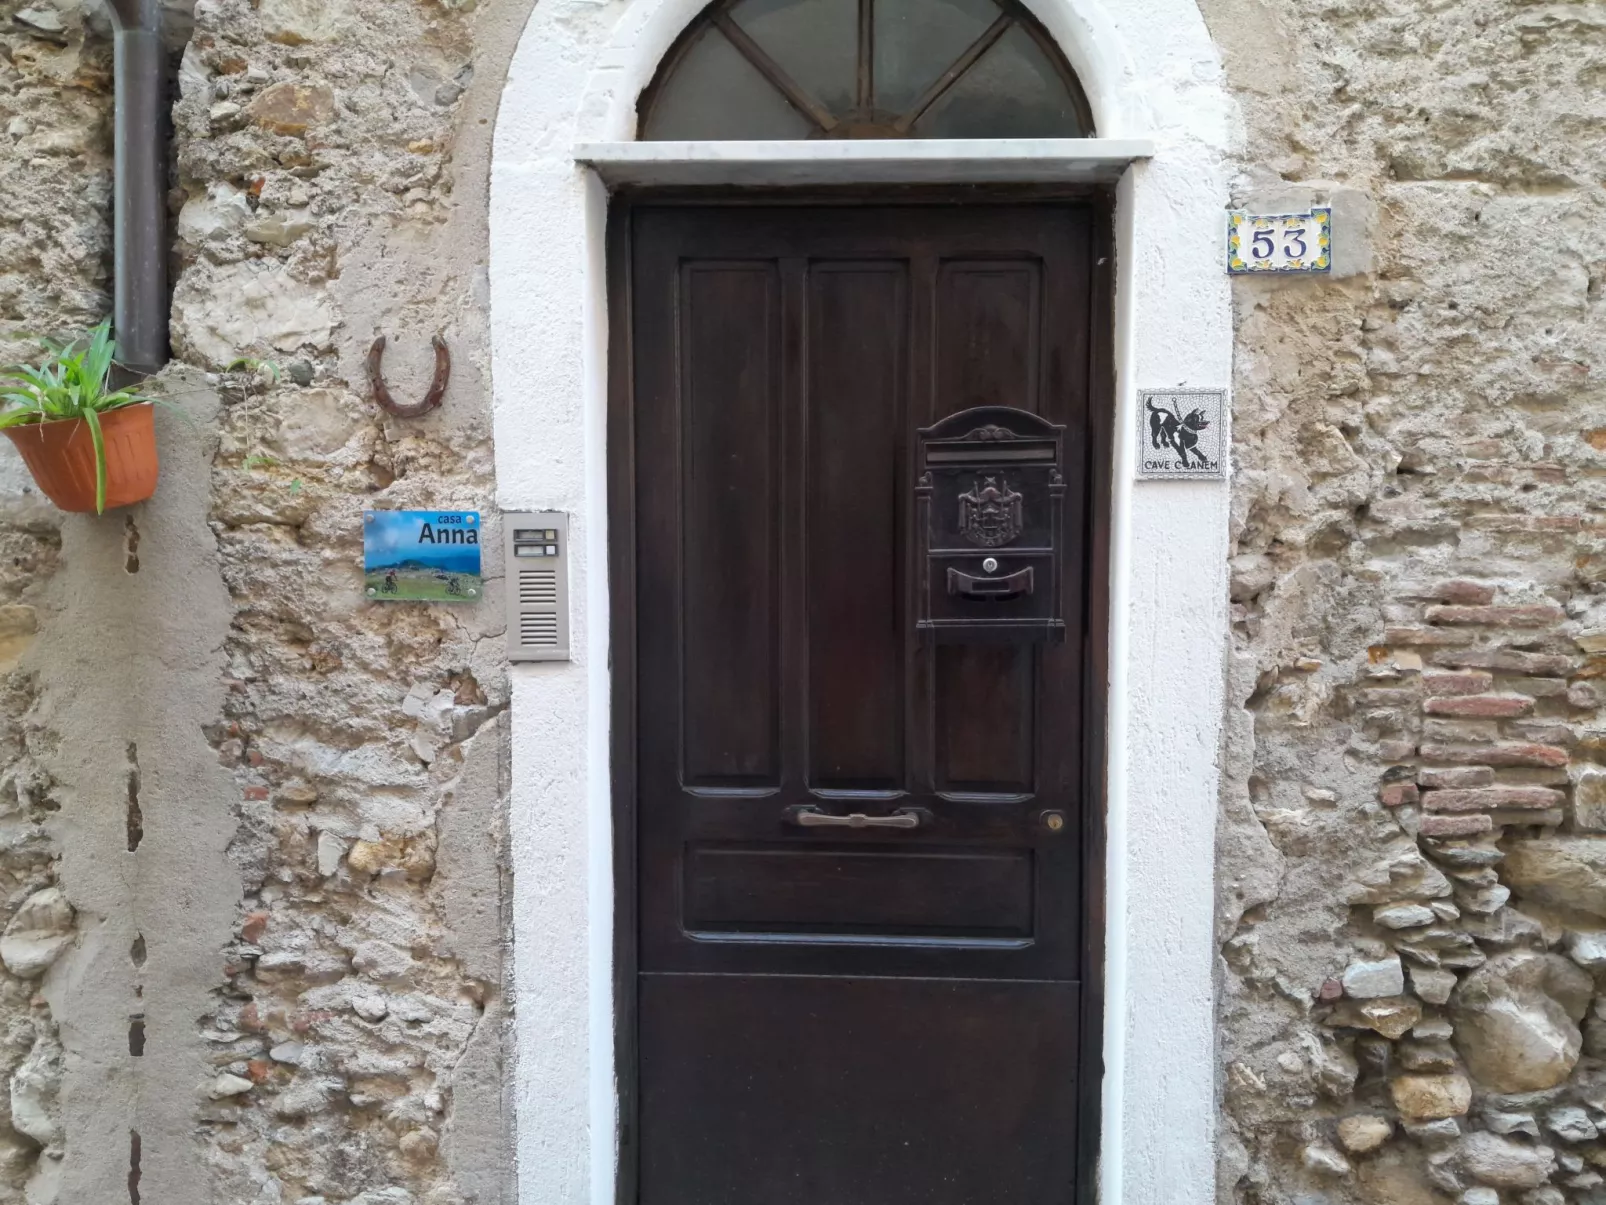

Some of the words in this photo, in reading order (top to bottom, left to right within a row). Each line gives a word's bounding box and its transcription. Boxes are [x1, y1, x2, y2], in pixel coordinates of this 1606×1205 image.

[1252, 229, 1307, 258] 53
[1144, 460, 1170, 470] CAVE
[437, 514, 462, 524] casa
[418, 523, 478, 544] Anna
